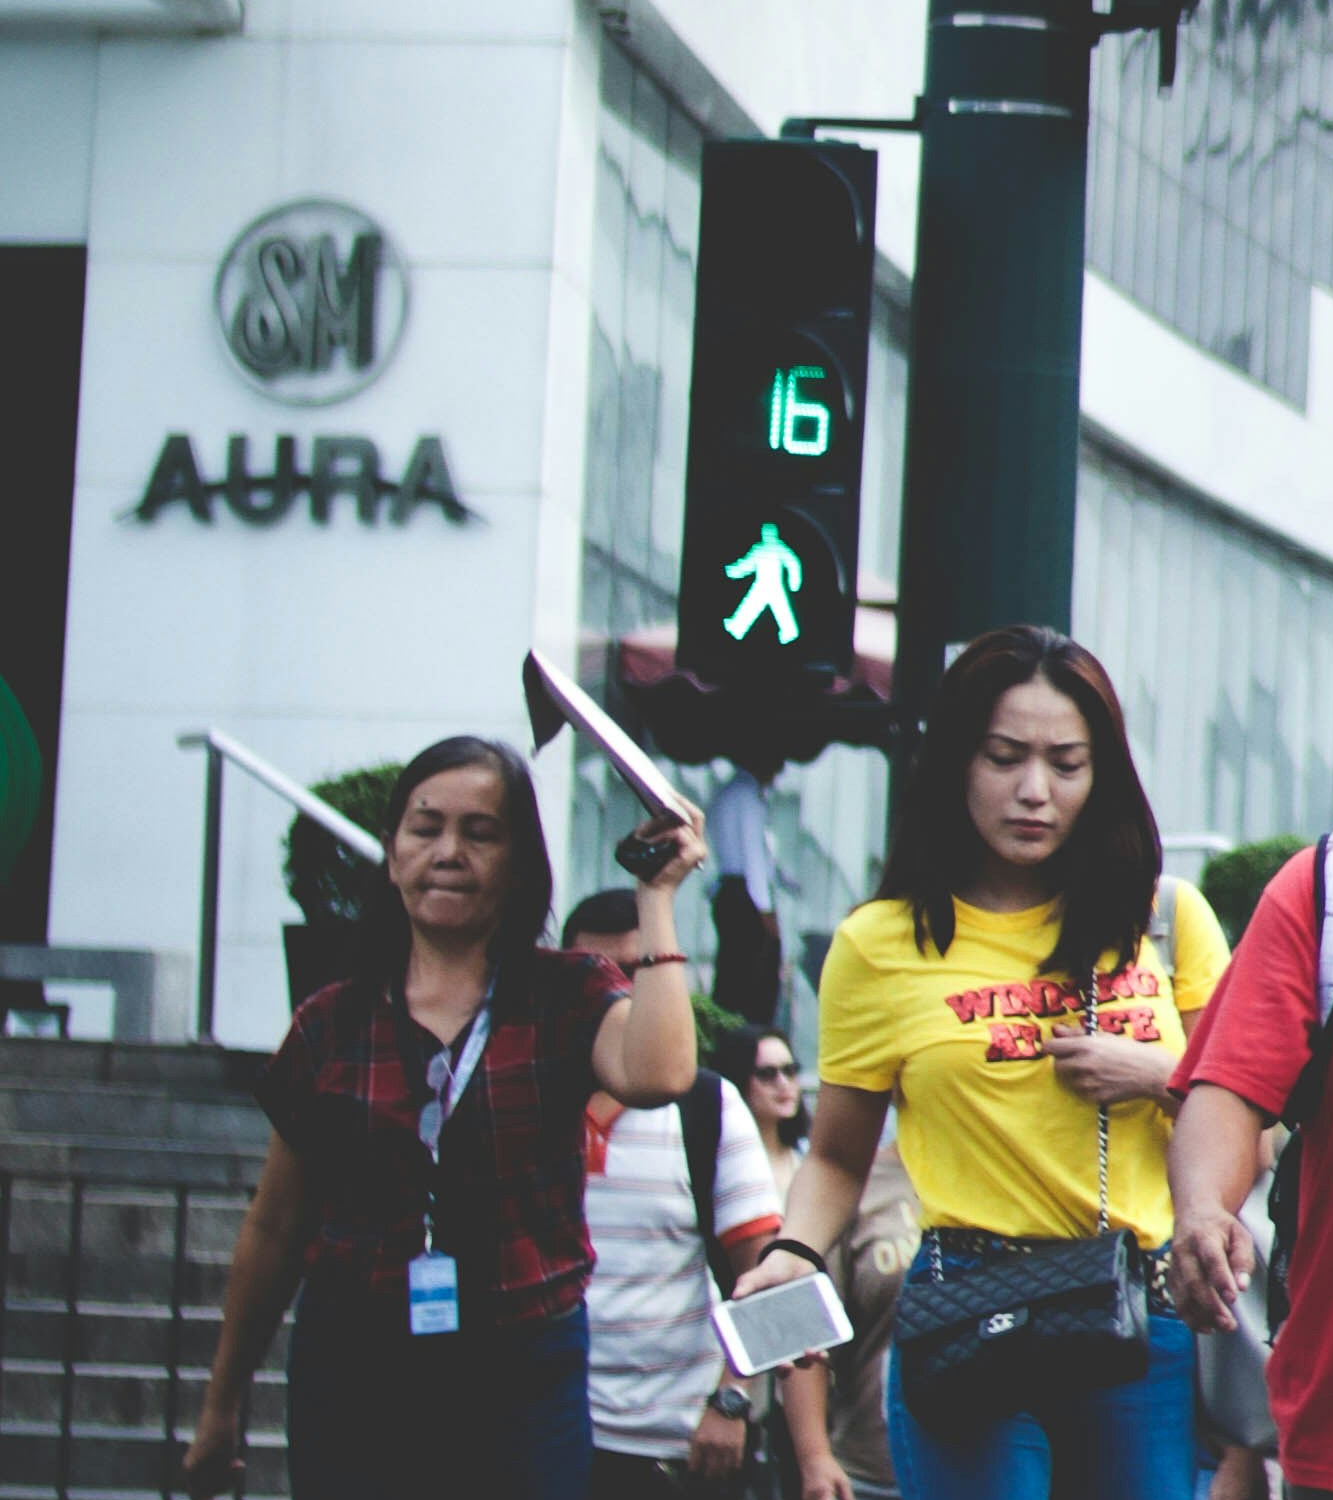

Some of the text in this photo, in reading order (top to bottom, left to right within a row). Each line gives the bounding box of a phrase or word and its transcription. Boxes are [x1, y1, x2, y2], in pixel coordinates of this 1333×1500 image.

[230, 232, 384, 382] SM
[769, 365, 830, 457] 16
[135, 432, 470, 528] AURA
